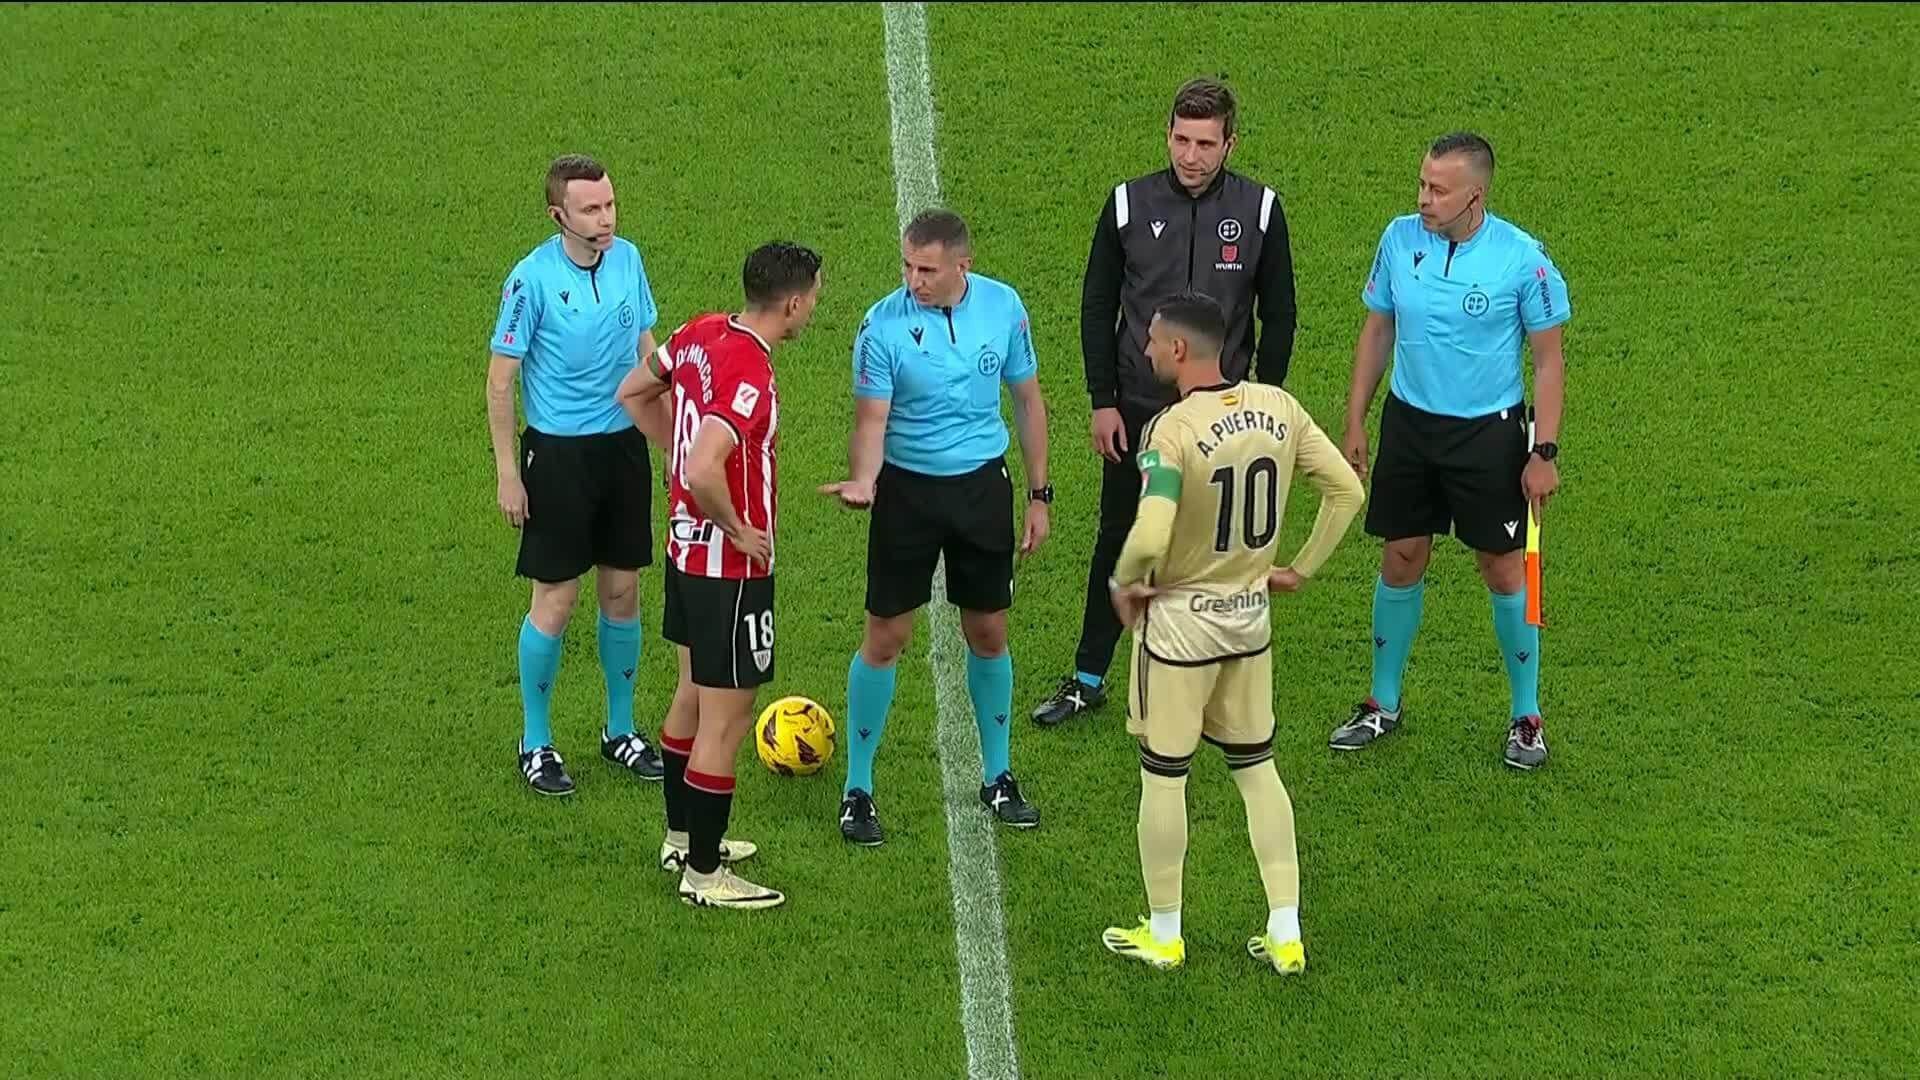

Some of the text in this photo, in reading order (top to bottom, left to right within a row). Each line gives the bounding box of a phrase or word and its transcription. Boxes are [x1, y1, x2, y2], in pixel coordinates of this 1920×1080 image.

[1197, 410, 1288, 459] A.PUERTAS
[1210, 456, 1278, 552] 10
[743, 609, 774, 650] 18
